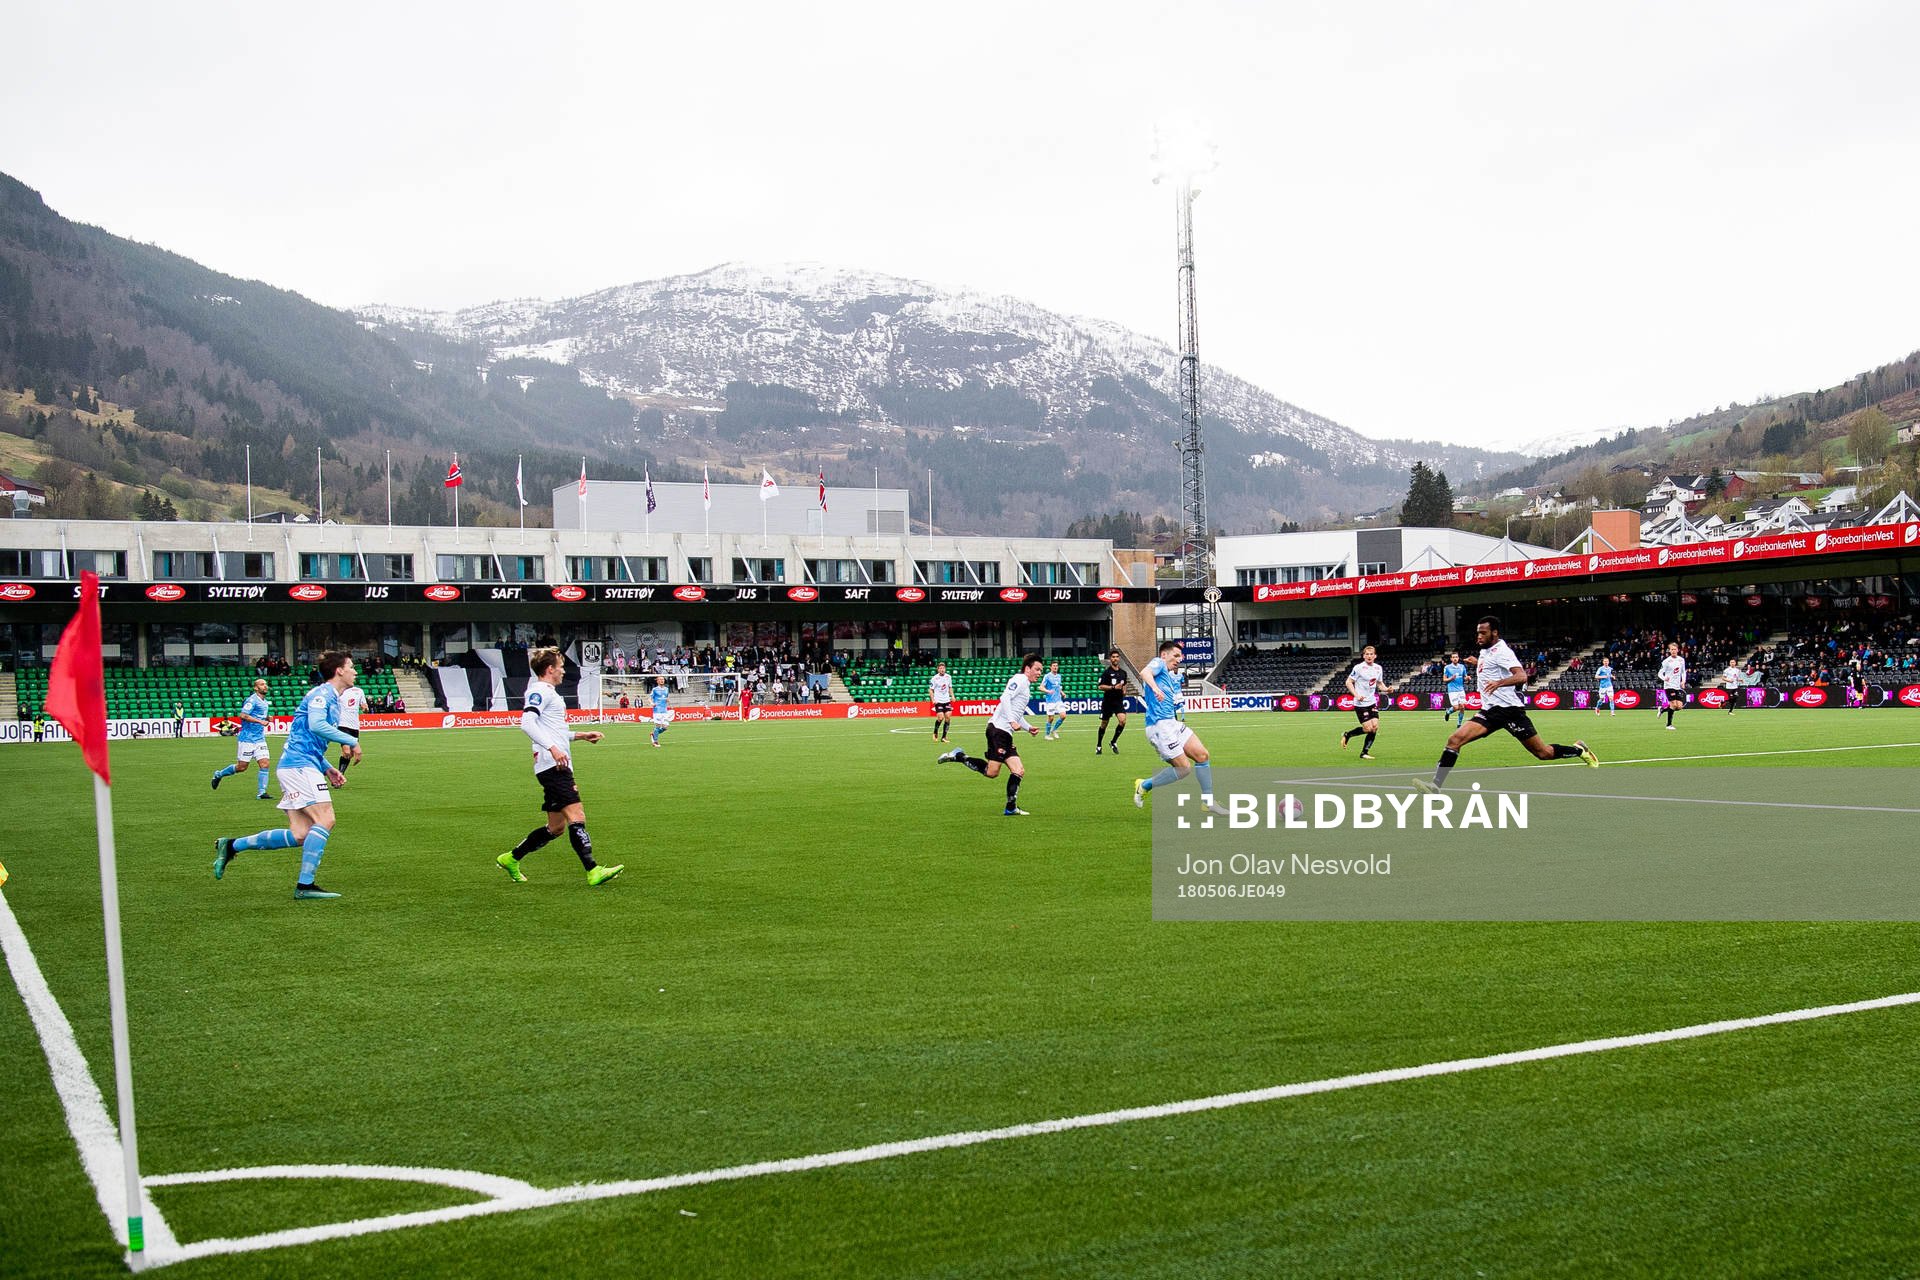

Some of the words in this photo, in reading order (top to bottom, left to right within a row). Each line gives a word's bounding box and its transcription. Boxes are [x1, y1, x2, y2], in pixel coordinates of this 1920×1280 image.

[1827, 530, 1894, 546] SparebankenVest
[1745, 539, 1806, 553] SparebankenVest
[1669, 546, 1725, 561] SparebankenVest
[1533, 560, 1582, 573] SparebankenVest
[1598, 554, 1650, 568] SparebankenVest
[1417, 572, 1459, 585] SparebankenVest
[1473, 566, 1518, 579] SparebankenVest
[1317, 582, 1353, 592] SparebankenVest
[1365, 577, 1405, 588] SparebankenVest
[73, 586, 109, 598] ST
[208, 585, 267, 598] SYLTETØY
[365, 586, 389, 598] JUS
[491, 587, 521, 599] SAFT
[605, 587, 655, 599] SYLTETØY
[736, 588, 757, 599] JUS
[844, 588, 870, 599] SAFT
[941, 589, 984, 600] SYLTETØY
[1054, 589, 1071, 600] JUS
[1269, 586, 1305, 597] SparebankenVest
[1186, 640, 1211, 648] mesta
[1186, 652, 1212, 660] mesta
[960, 702, 997, 715] umbr
[1188, 696, 1272, 710] INTERSPORT
[761, 709, 822, 718] SparebankenVest
[859, 706, 918, 715] SparebankenVest
[456, 716, 523, 727] SparebankenVes
